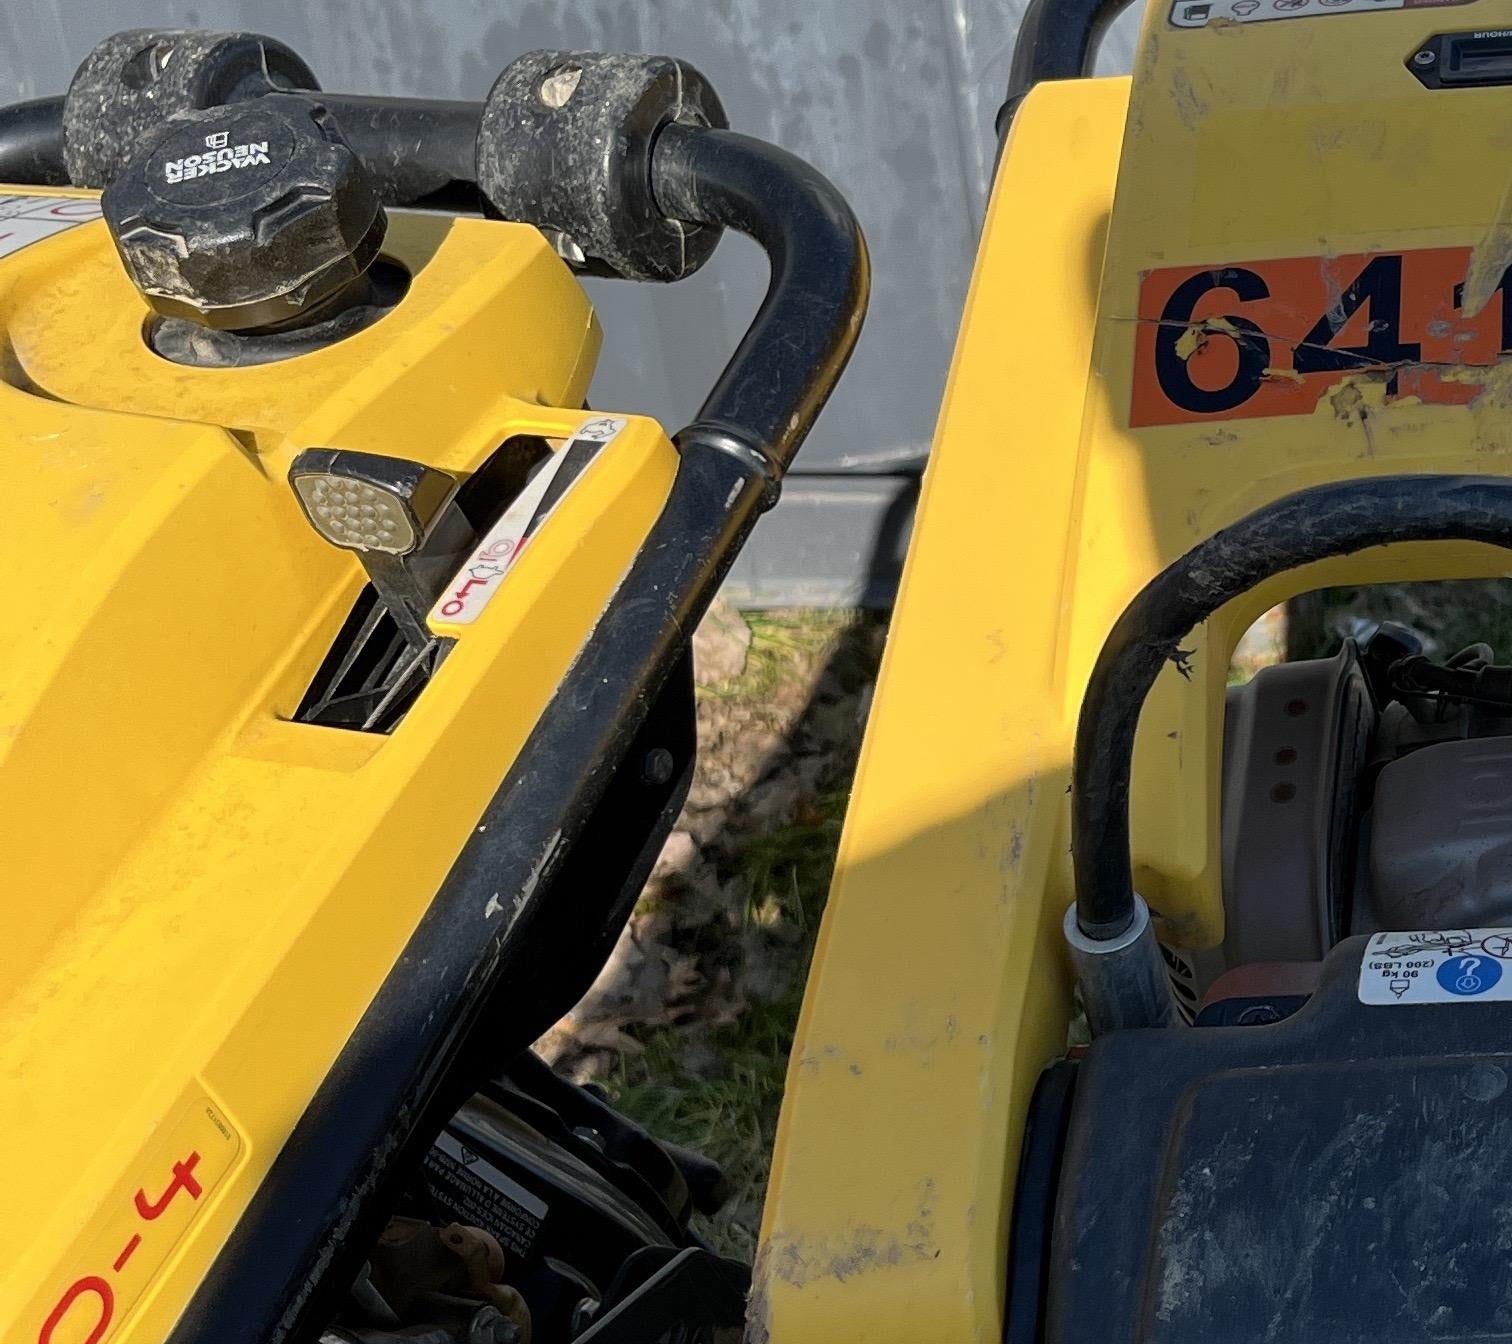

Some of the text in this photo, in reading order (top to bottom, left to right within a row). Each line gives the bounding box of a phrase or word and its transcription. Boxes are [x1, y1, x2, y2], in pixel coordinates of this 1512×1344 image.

[165, 141, 269, 177] NEUSON
[165, 153, 271, 184] WACKER
[1382, 969, 1419, 978] 90 kg
[1405, 959, 1435, 969] (200
